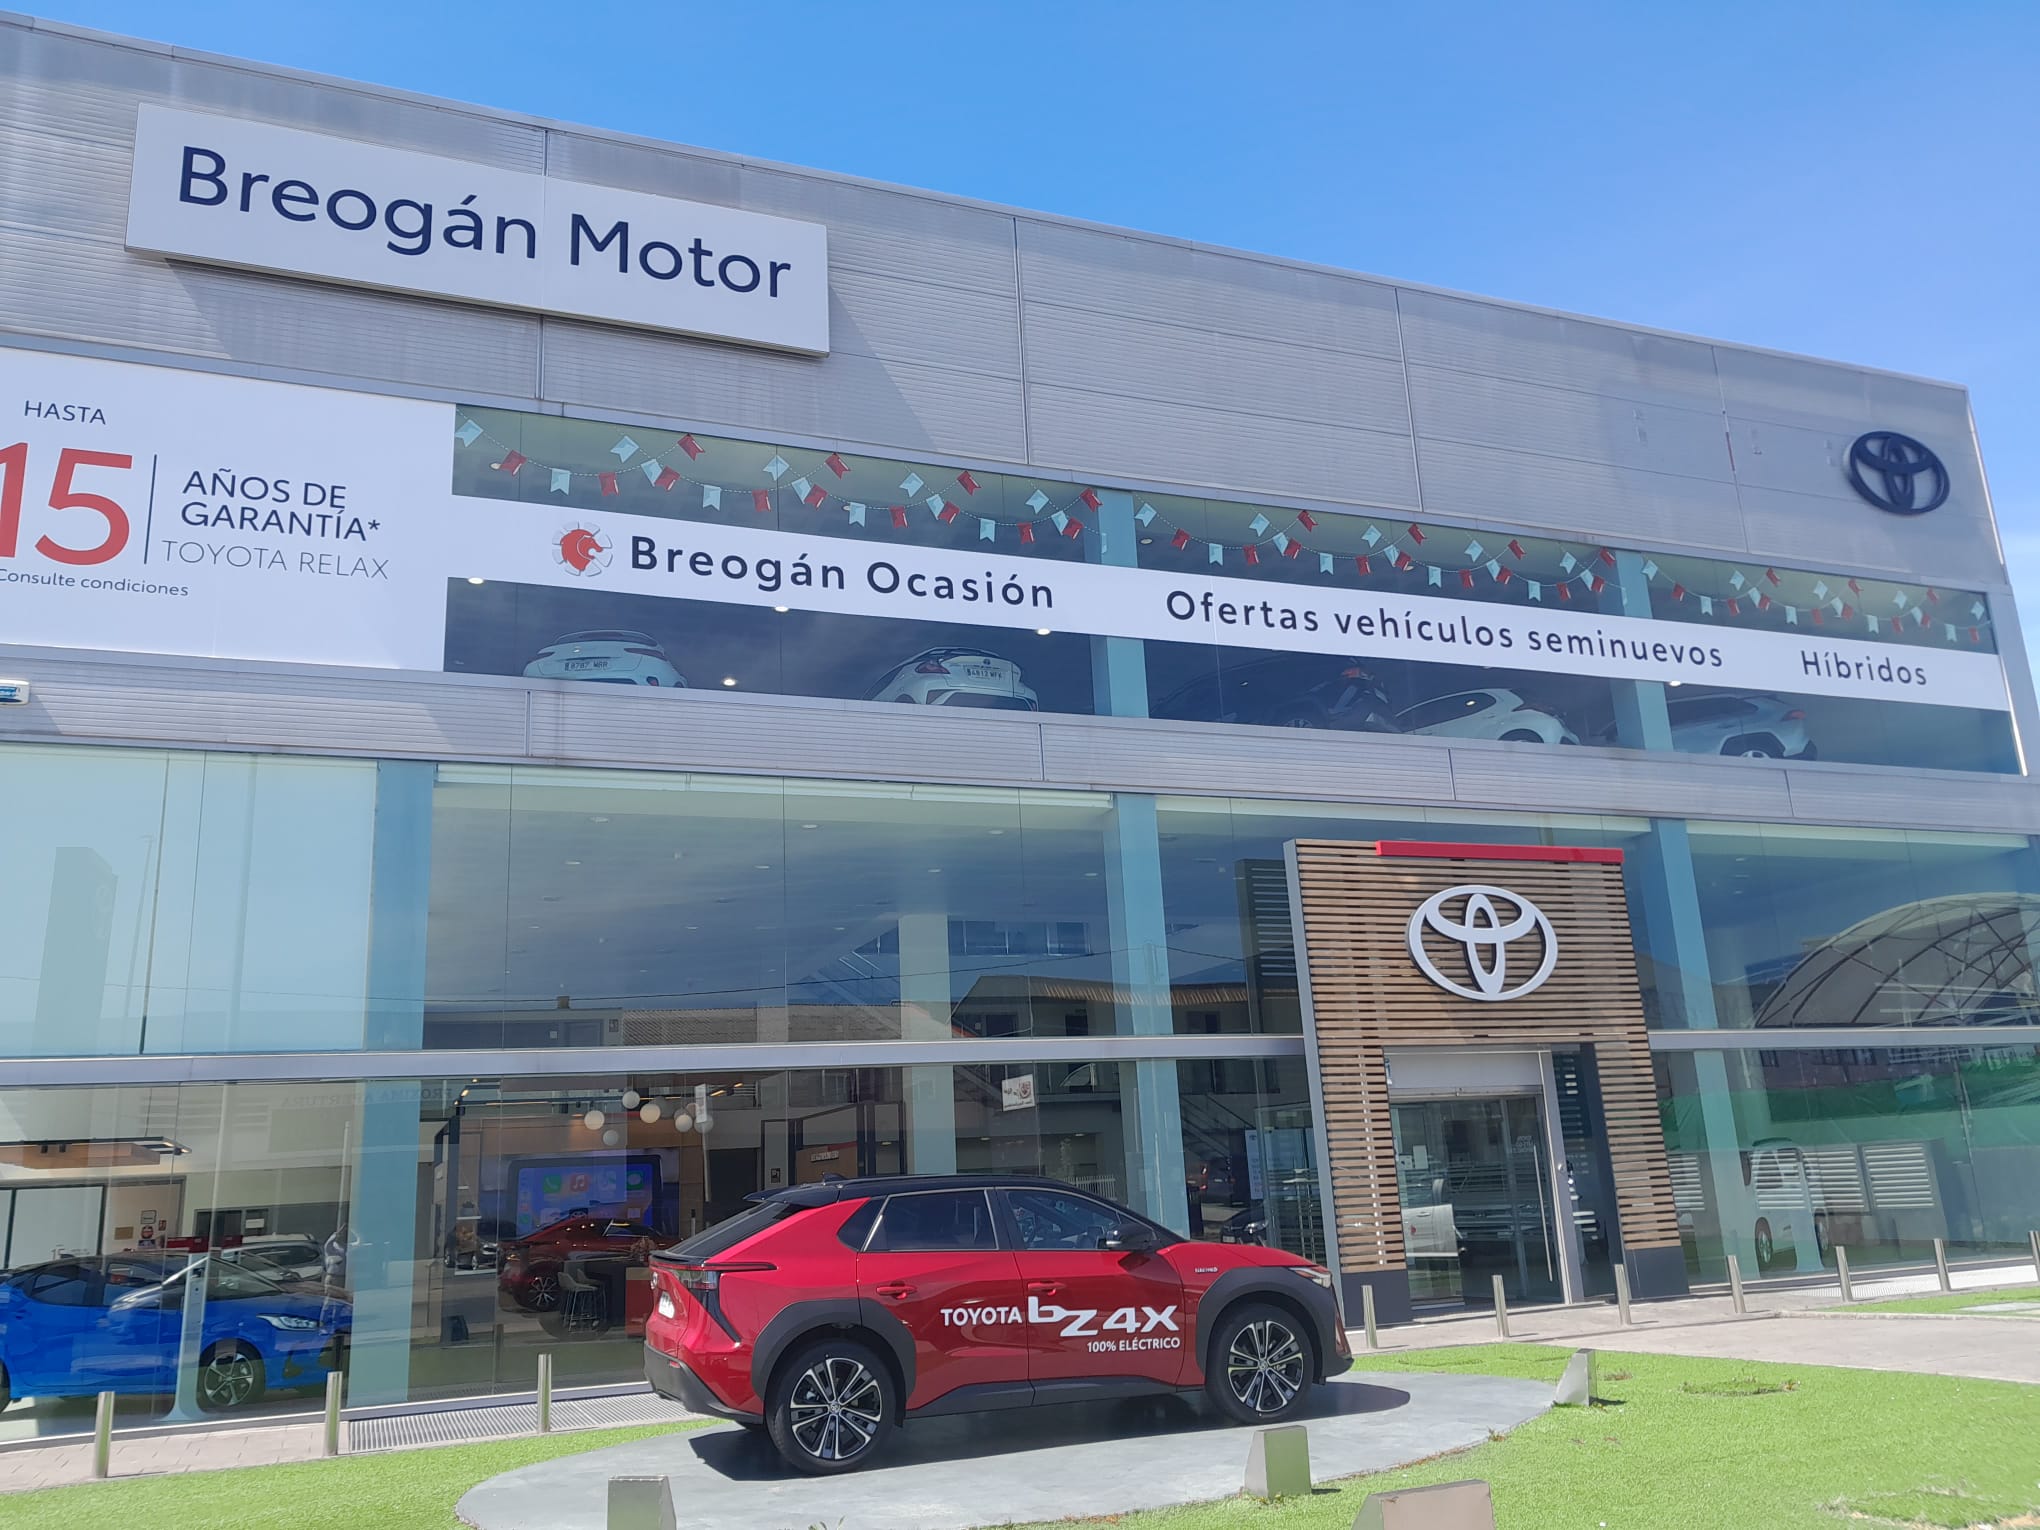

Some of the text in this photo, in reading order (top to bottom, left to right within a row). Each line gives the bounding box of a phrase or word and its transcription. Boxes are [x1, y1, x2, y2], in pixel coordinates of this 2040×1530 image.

[179, 145, 792, 298] Breogán Motor
[24, 400, 106, 425] HASTA
[0, 441, 133, 565] 15
[182, 468, 347, 509] AÑOS DE
[162, 540, 390, 580] TOYOTA RELAX
[631, 535, 1053, 608] Breogán Ocasión
[80, 578, 189, 597] condiciones
[1166, 590, 1723, 668] Ofertas vehículos seminuevos
[1801, 649, 1928, 686] Híbridos
[940, 1305, 1023, 1326] TOYOTA
[1087, 1336, 1181, 1353] 100% ELÉCTRICO
